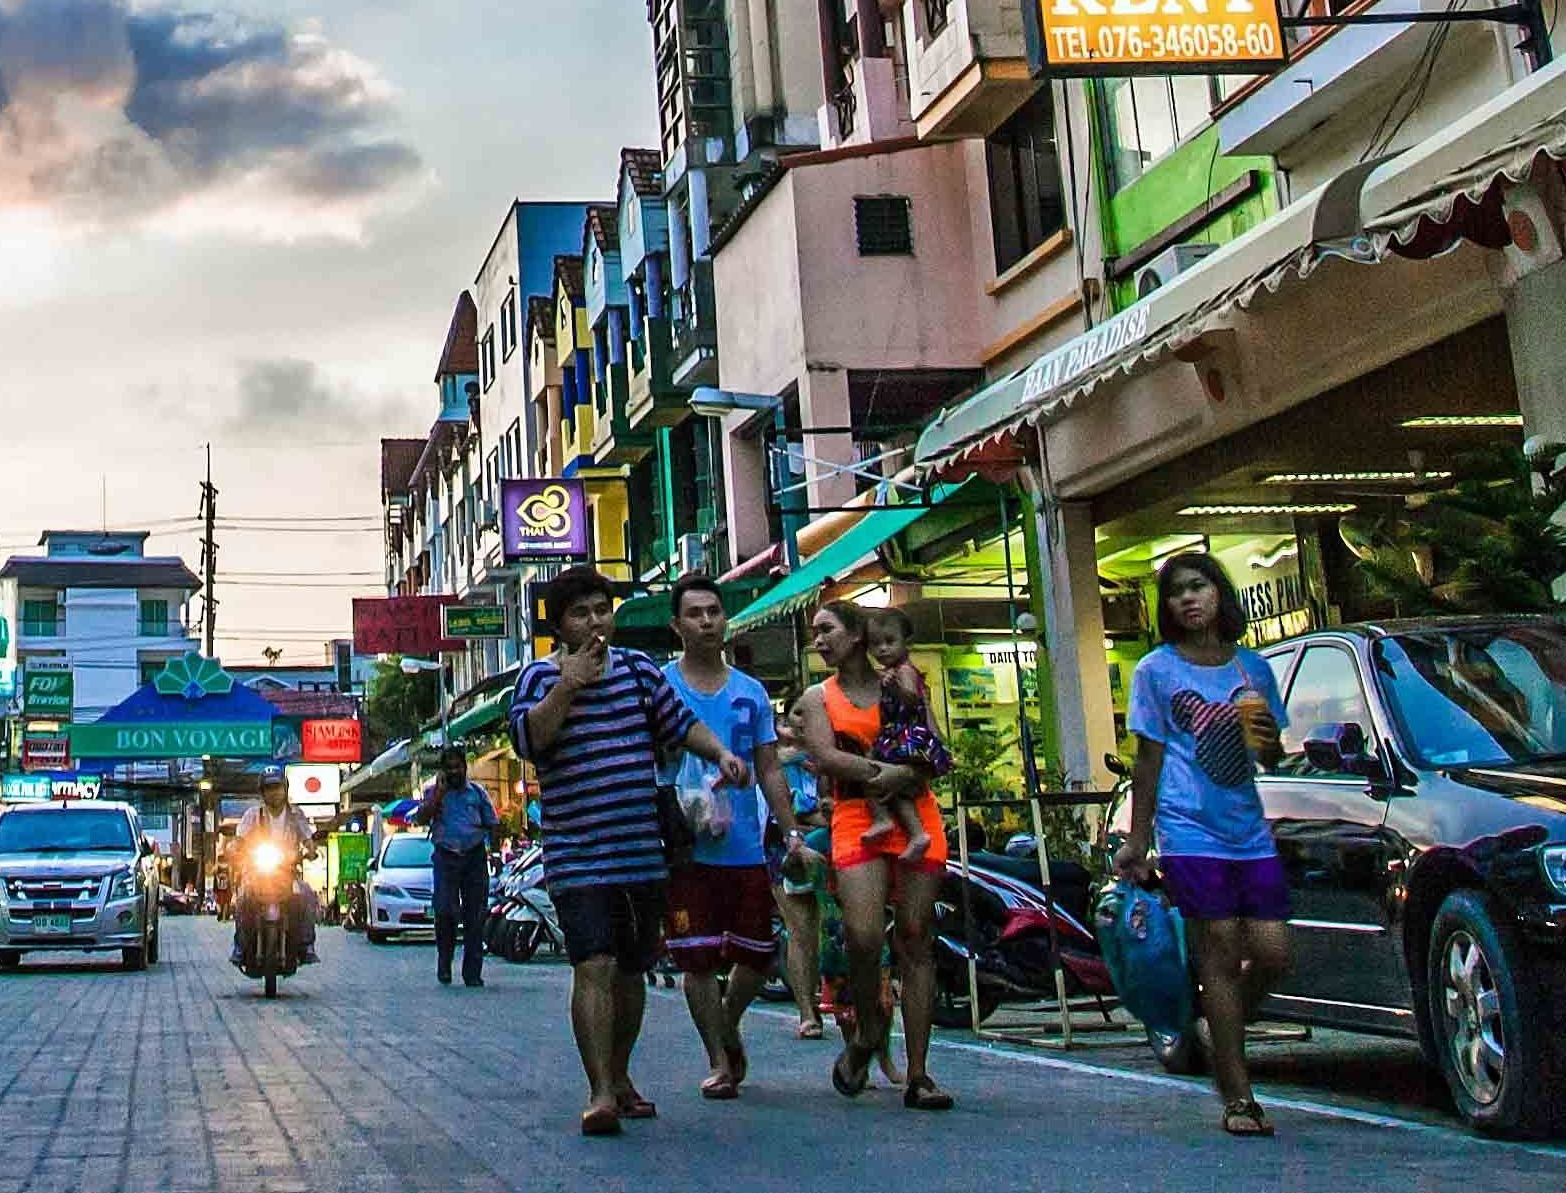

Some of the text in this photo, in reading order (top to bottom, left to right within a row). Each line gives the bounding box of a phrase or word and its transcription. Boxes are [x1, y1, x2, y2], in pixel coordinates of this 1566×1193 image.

[1021, 303, 1151, 404] BAAN PARADISE
[518, 527, 544, 537] THAI
[117, 729, 165, 749] BON
[173, 729, 272, 749] VOYAGE
